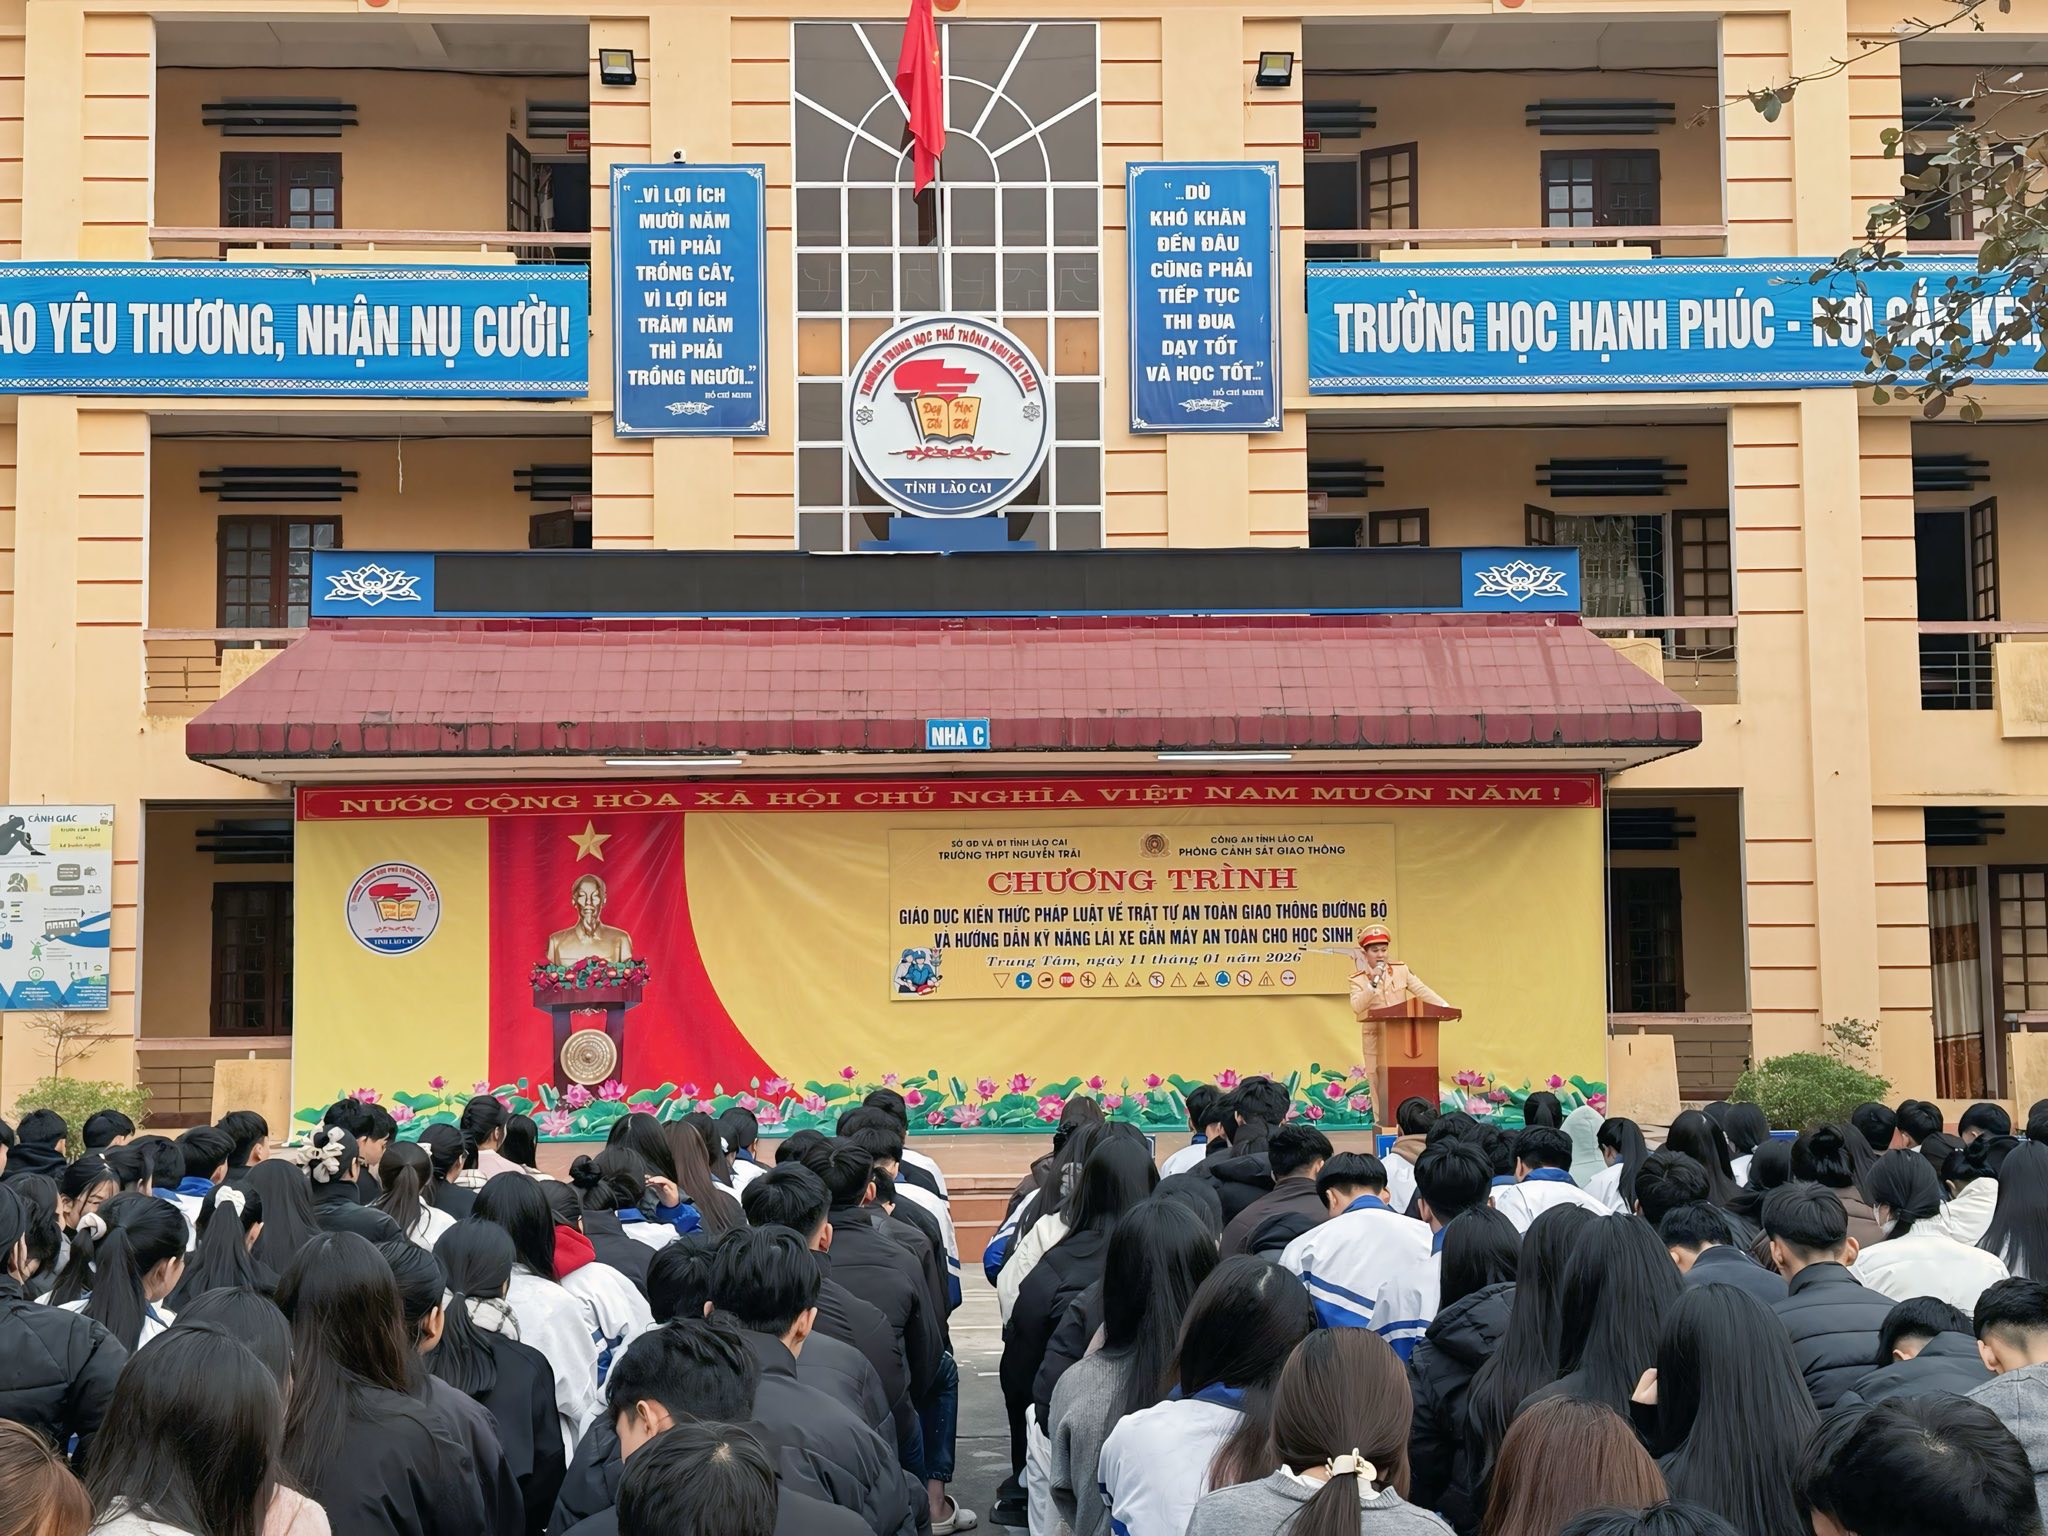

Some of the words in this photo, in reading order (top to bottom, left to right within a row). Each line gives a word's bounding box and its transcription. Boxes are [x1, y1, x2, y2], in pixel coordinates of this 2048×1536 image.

[665, 187, 691, 206] LỢI
[697, 185, 725, 203] ÍCH
[640, 210, 684, 229] MƯỜI
[690, 210, 730, 229] NĂM
[1150, 207, 1188, 226] KHÓ
[1194, 207, 1246, 226] KHĂN
[649, 237, 676, 255] THÌ
[681, 234, 721, 255] PHẢI
[1157, 232, 1195, 252] ĐẾN
[1201, 233, 1239, 252] ĐÂU
[635, 260, 693, 281] TRỒNG
[699, 262, 734, 283] CÂY,
[1150, 259, 1203, 278] CŨNG
[1208, 257, 1252, 277] PHẢI
[644, 288, 660, 307] VÌ
[666, 290, 692, 310] LỢI
[698, 288, 727, 307] ÍCH
[1157, 283, 1199, 304] TIẾP
[1204, 287, 1240, 306] TỤC
[48, 291, 117, 354] YÊU
[128, 298, 285, 362] THƯƠNG,
[297, 294, 399, 368] NHẬN
[411, 305, 461, 368] NỤ
[473, 293, 570, 357] CƯỜI!
[638, 314, 687, 333] TRĂM
[693, 314, 733, 333] NĂM
[1163, 314, 1192, 330] THI
[1198, 314, 1236, 330] ĐUA
[1333, 289, 1475, 353] TRƯỜNG
[1486, 300, 1558, 364] HỌC
[1569, 300, 1667, 363] HẠNH
[1679, 287, 1775, 349] PHÚC
[649, 340, 676, 359] THÌ
[682, 338, 722, 359] PHẢI
[883, 338, 912, 363] TRUNG
[913, 331, 933, 346] HỌC
[957, 329, 989, 347] THÔNG
[1161, 340, 1198, 358] DẠY
[1204, 334, 1238, 355] TỐT
[628, 365, 685, 385] TRỒNG
[1146, 363, 1171, 382] VÀ
[1176, 365, 1214, 384] HỌC
[941, 480, 966, 494] LÀO
[969, 482, 991, 494] CAI
[931, 722, 968, 746] NHÀ
[972, 727, 984, 745] C
[339, 795, 453, 813] NƯỚC
[465, 793, 580, 813] CỘNG
[593, 790, 682, 807] HÒA
[694, 790, 753, 805] XÃ
[766, 789, 841, 807] HỘI
[854, 786, 937, 805] CHỦ
[950, 787, 1084, 804] NGHĨA
[1097, 784, 1192, 804] VIỆT
[1204, 786, 1299, 800] NAM
[1311, 784, 1434, 801] MUÔN
[1446, 784, 1542, 800] NĂM
[28, 813, 54, 823] CẢNH
[56, 814, 78, 823] GIÁC
[982, 838, 993, 847] VÀ
[1031, 838, 1049, 847] LÀO
[1178, 846, 1217, 856] PHÒNG
[1277, 846, 1305, 855] GIAO
[1308, 844, 1345, 854] THÔNG
[1211, 836, 1238, 844] CÔNG
[1278, 835, 1295, 843] LÀO
[1297, 835, 1314, 843] CAI
[938, 850, 982, 860] TRƯỜNG
[985, 850, 1009, 859] THPT
[987, 867, 1157, 894] CHƯƠNG
[1167, 863, 1298, 891] TRÌNH
[899, 906, 929, 925] GIÁO
[933, 908, 959, 928] DỤC
[963, 903, 993, 924] KIẾN
[997, 904, 1030, 924] THỨC
[1034, 903, 1069, 923] PHÁP
[1073, 903, 1104, 925] LUẬT
[1127, 902, 1158, 925] TRẬT
[1162, 904, 1179, 924] TỰ
[1182, 904, 1200, 920] AN
[1204, 901, 1238, 920] TOÀN
[1242, 904, 1272, 920] GIAO
[1276, 900, 1318, 920] THÔNG
[1322, 899, 1366, 919] ĐƯỜNG
[1370, 900, 1387, 922] BỘ
[934, 925, 951, 949] VÀ
[955, 928, 999, 948] HƯỚNG
[1034, 928, 1050, 947] KỸ
[1054, 928, 1091, 947] NĂNG
[1095, 927, 1114, 945] LÁI
[1119, 930, 1135, 945] XE
[1170, 925, 1198, 944] MÁY
[1202, 928, 1221, 944] AN
[1224, 925, 1258, 944] TOÀN
[1262, 927, 1288, 943] CHO
[1292, 927, 1318, 946] HỌC
[1322, 927, 1353, 943] SINH
[987, 956, 1036, 968] Trung
[1041, 955, 1080, 968] Tâm,
[1086, 955, 1125, 968] ngày
[1130, 954, 1145, 965] 11
[1152, 952, 1199, 966] tháng
[1203, 953, 1220, 964] 01
[1226, 952, 1261, 963] năm
[1265, 952, 1302, 963] 2026
